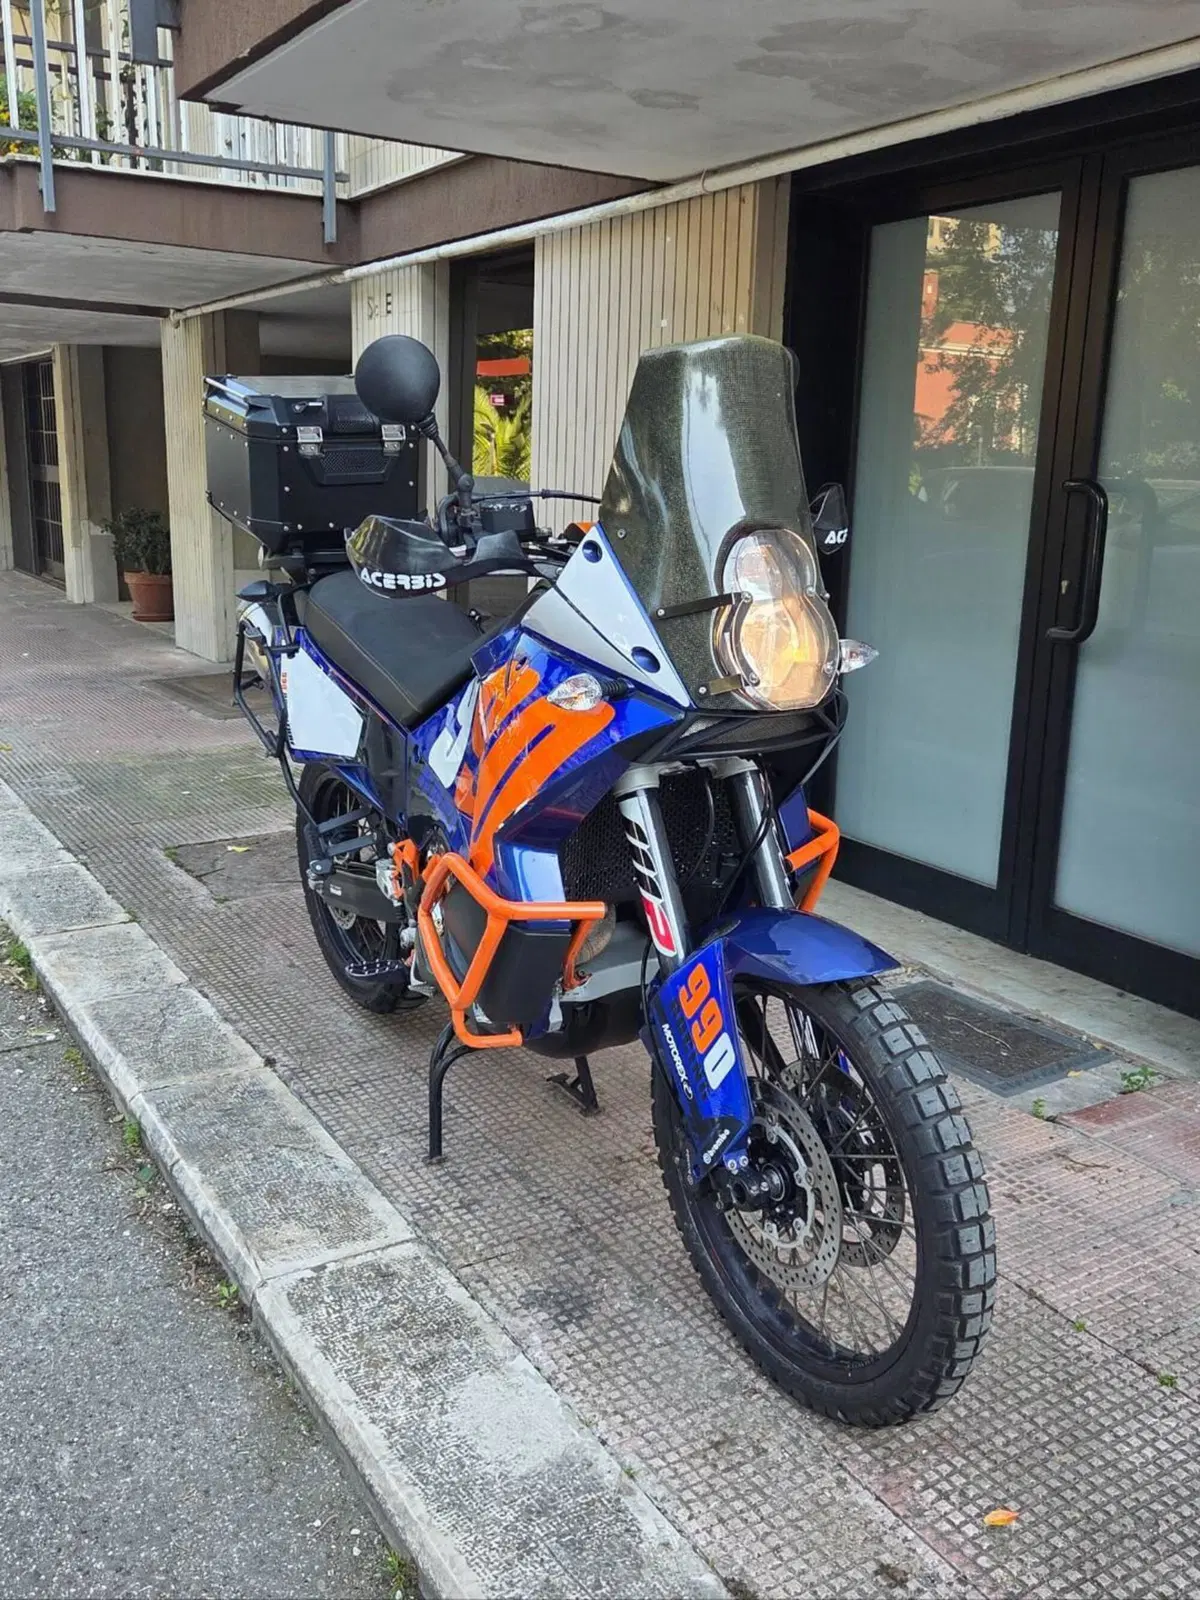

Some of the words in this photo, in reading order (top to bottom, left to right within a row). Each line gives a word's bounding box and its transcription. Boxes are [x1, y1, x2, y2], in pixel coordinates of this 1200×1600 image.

[361, 567, 447, 590] ACERBIS
[679, 963, 736, 1090] 990
[661, 1023, 689, 1083] MOTOREX
[707, 1129, 730, 1157] brembo
